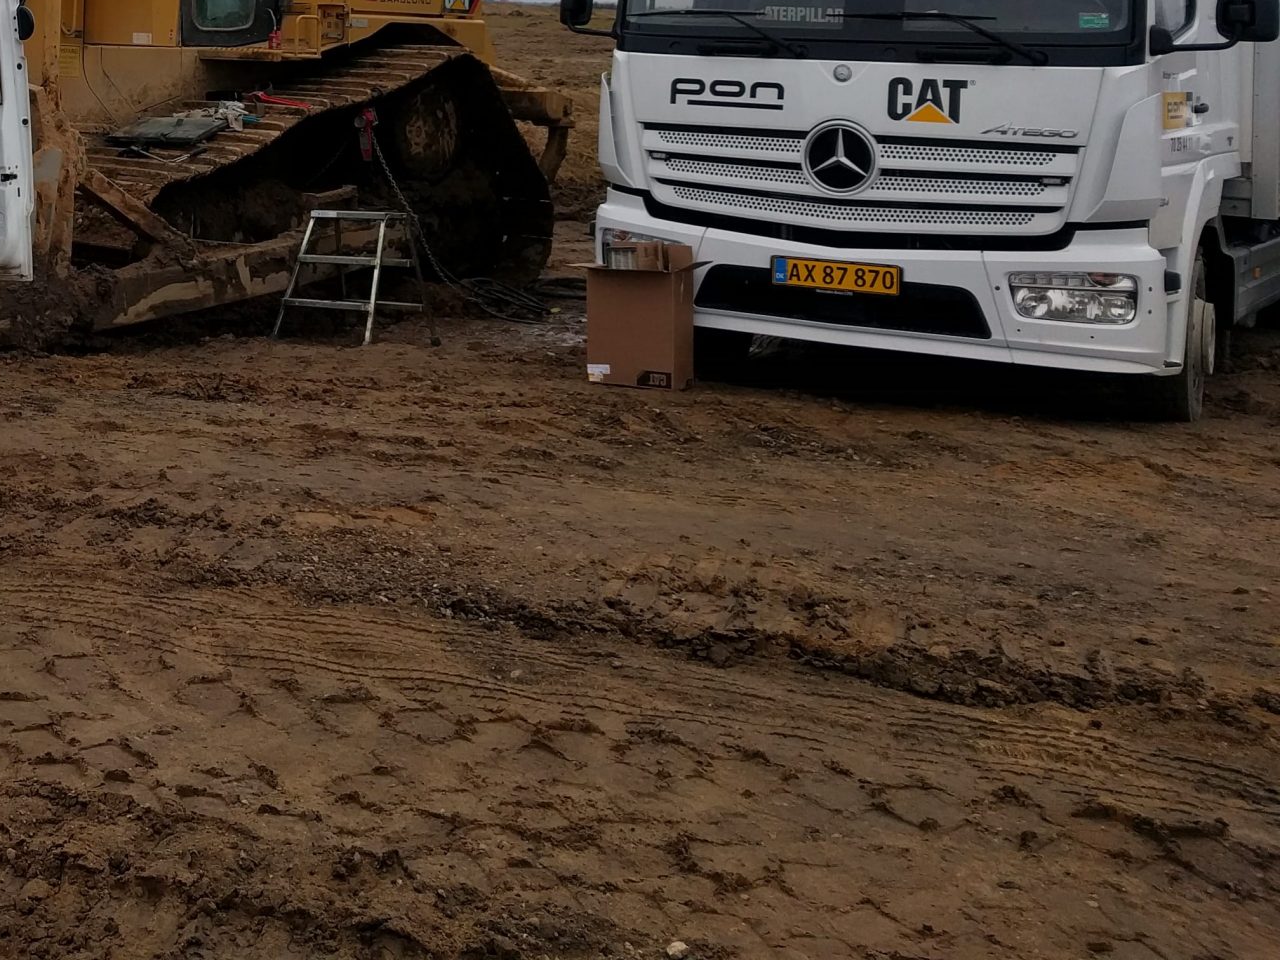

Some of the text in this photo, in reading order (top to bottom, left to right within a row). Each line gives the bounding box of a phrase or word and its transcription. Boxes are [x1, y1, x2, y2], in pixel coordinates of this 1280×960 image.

[670, 78, 784, 105] pon
[981, 122, 1080, 139] ATEGO
[788, 263, 895, 290] AX 87 870
